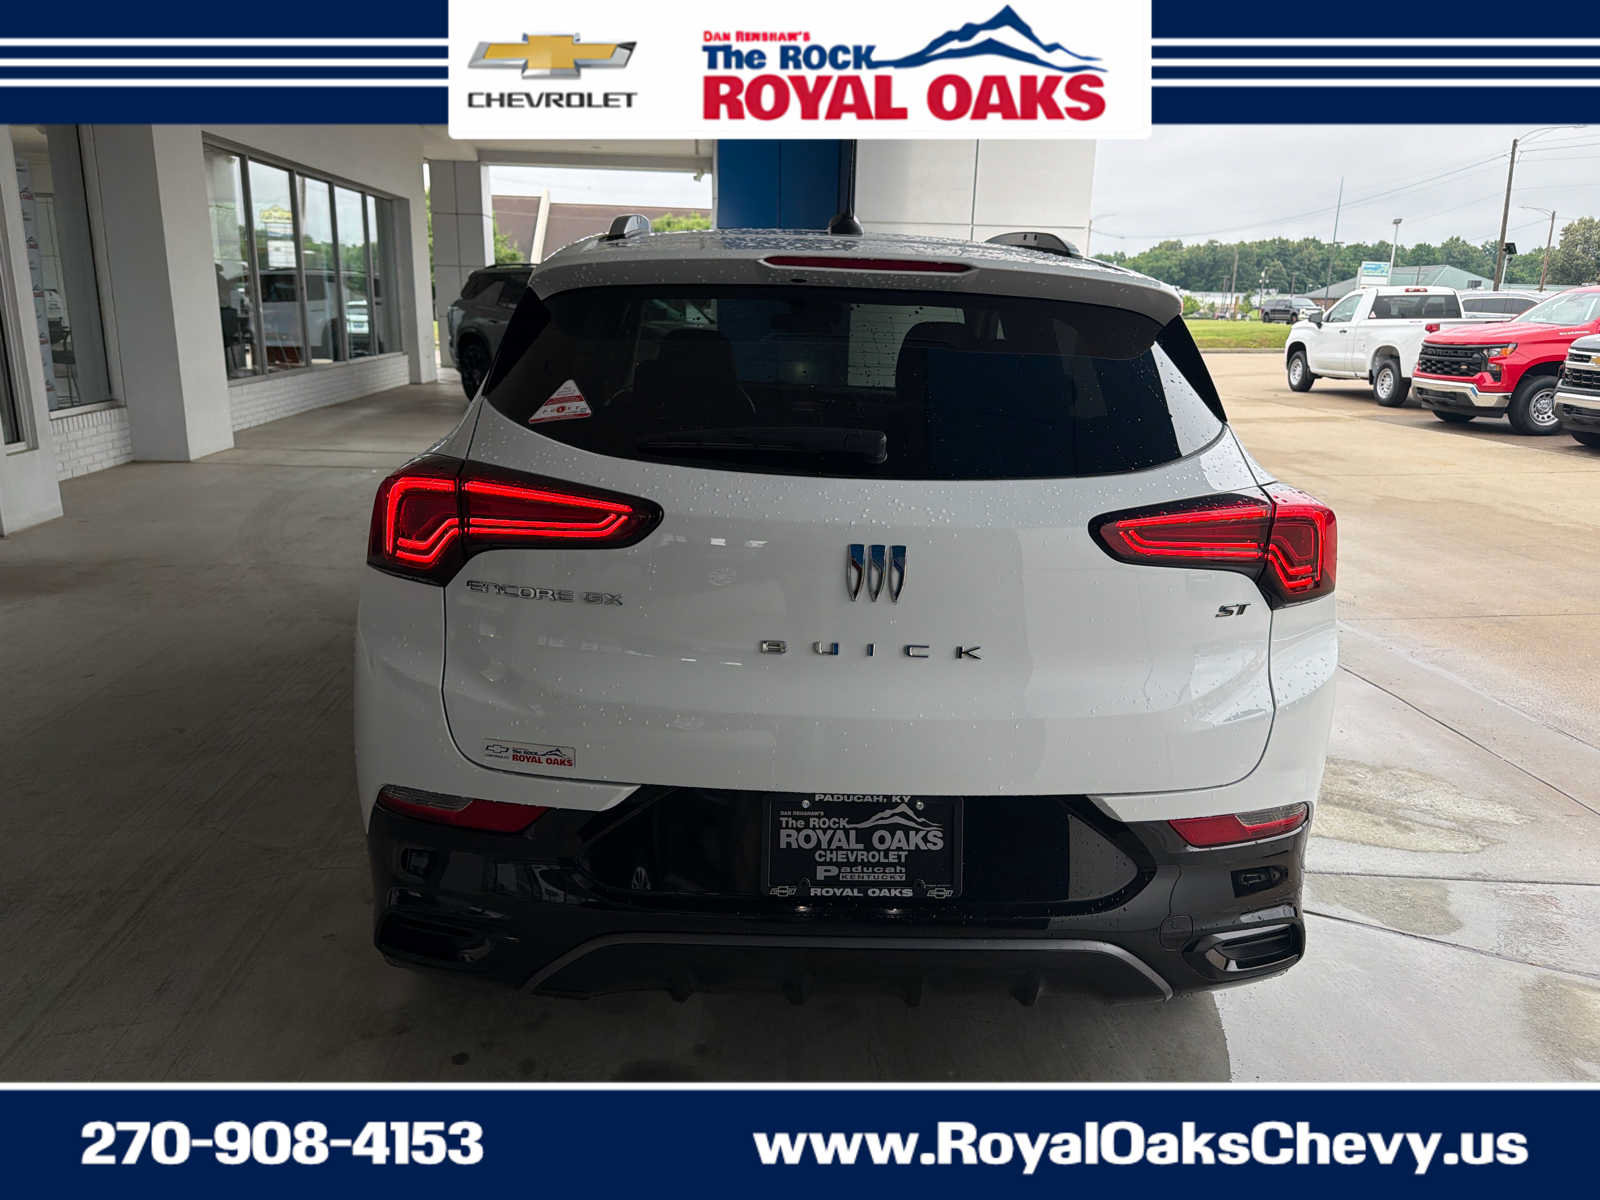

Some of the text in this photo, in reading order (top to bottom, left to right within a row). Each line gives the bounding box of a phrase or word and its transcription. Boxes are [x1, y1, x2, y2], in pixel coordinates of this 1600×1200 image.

[466, 580, 575, 602] ENCORE
[1215, 603, 1251, 617] ST
[760, 640, 981, 660] BUICK
[512, 754, 543, 764] ROYAL
[546, 758, 573, 767] OAKS
[815, 794, 912, 803] PADUCAH, KY
[780, 817, 848, 829] The ROCK
[779, 829, 944, 850] ROYAL OAKS
[815, 851, 908, 863] CHEVROLET
[816, 865, 906, 880] Paducah
[810, 888, 913, 897] ROYAL OAKS
